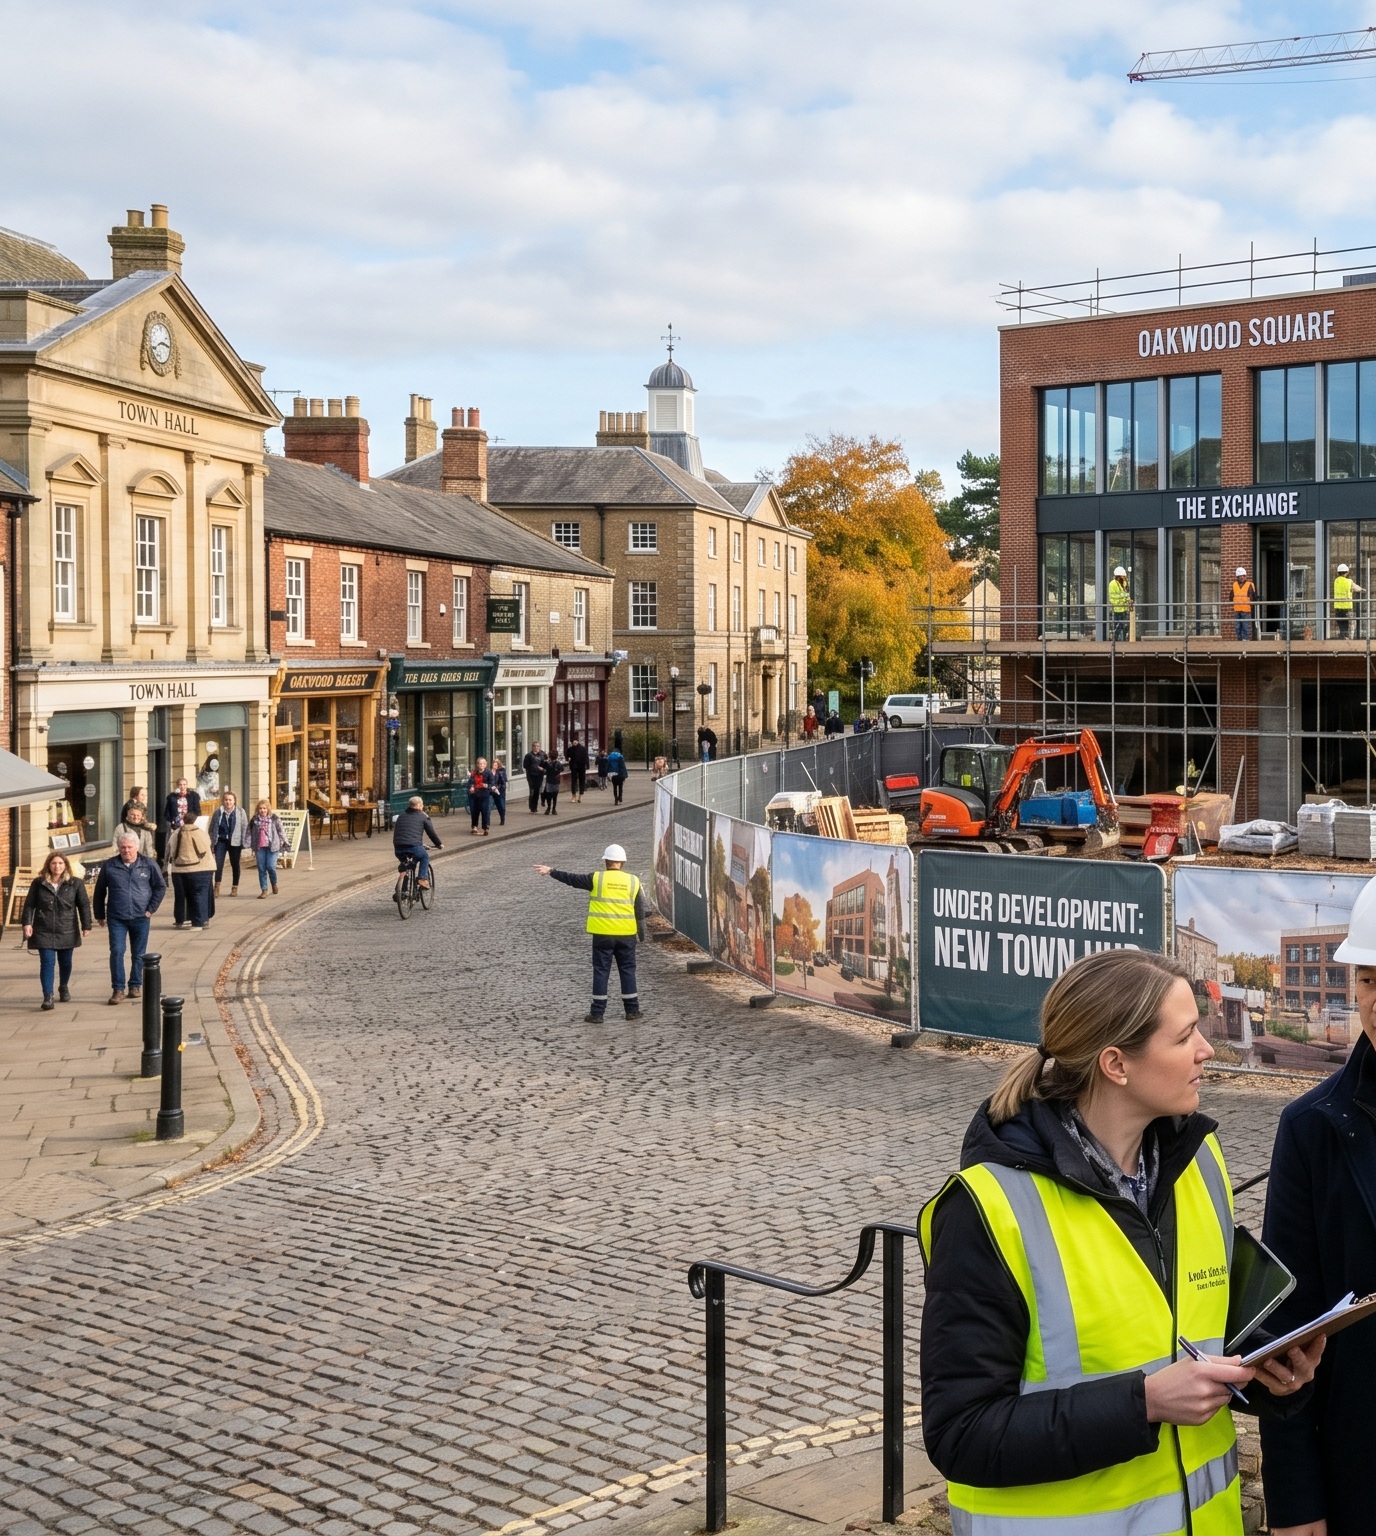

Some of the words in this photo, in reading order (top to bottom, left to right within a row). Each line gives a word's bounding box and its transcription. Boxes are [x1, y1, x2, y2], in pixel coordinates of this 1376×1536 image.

[1138, 320, 1242, 359] OAKWOOD
[1248, 309, 1336, 348] SQUARE
[117, 400, 159, 428] TOWN
[164, 410, 200, 436] HALL
[1176, 496, 1206, 521] THE
[1211, 491, 1299, 519] EXCHANGE
[129, 683, 164, 700] TOWN
[168, 682, 198, 699] HALL
[933, 887, 993, 922] UNDER
[998, 893, 1145, 935] DEVELOPMENT:
[934, 926, 990, 972] NEW
[997, 932, 1075, 979] TOWN
